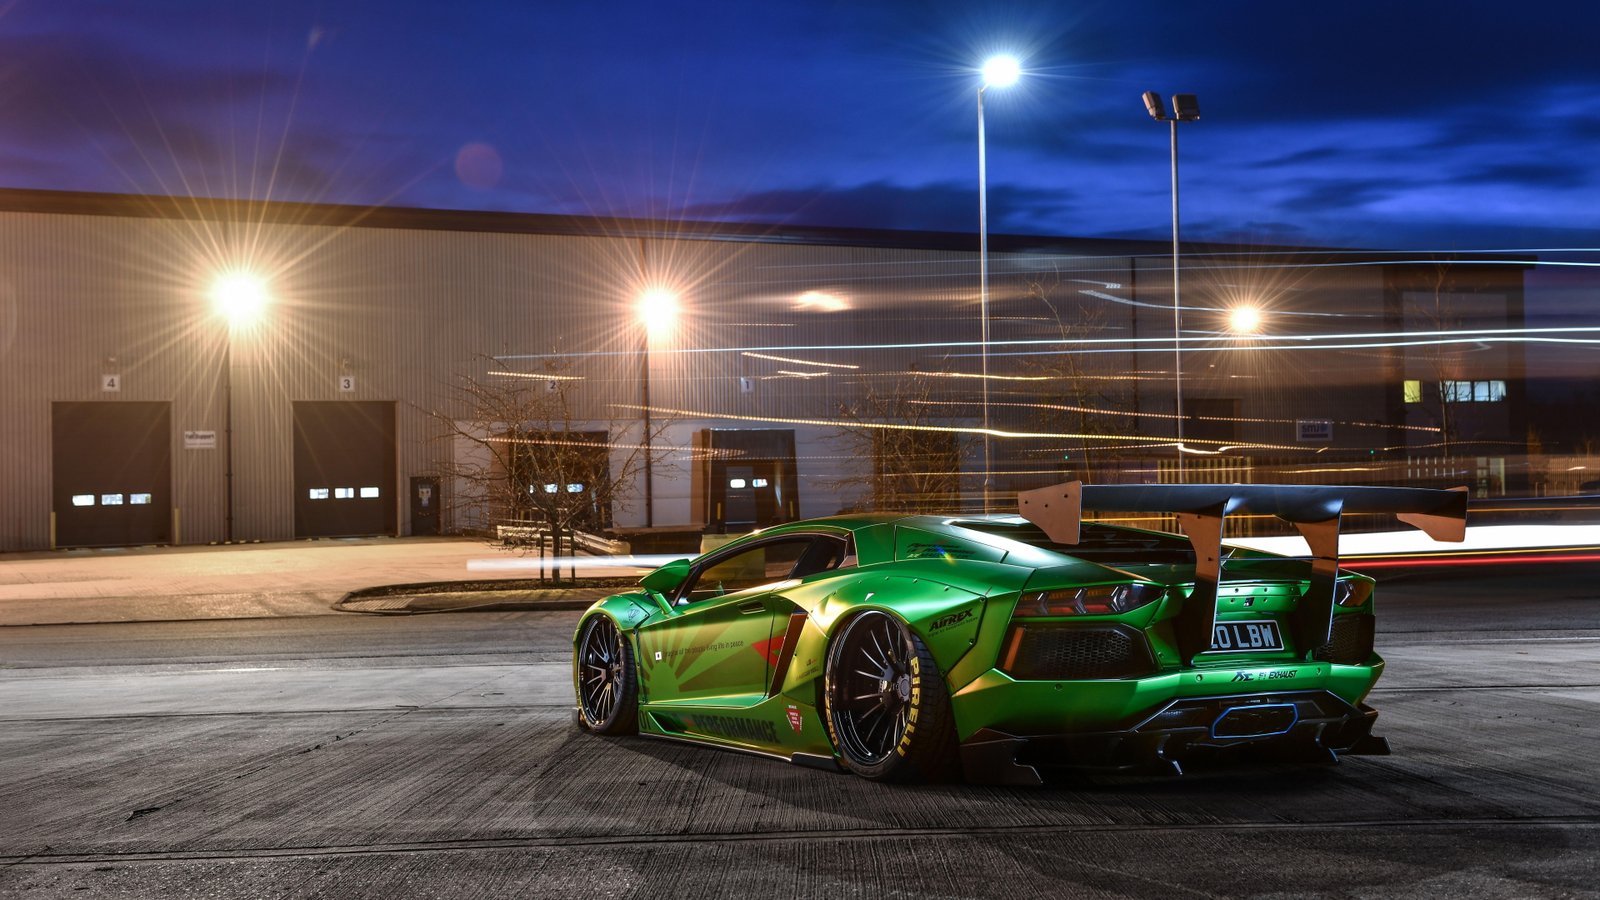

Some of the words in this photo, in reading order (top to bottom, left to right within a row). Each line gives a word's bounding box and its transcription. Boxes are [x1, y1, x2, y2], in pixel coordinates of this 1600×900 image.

[107, 378, 116, 388] 4
[343, 379, 351, 389] 3
[1233, 624, 1275, 648] LBW
[730, 640, 744, 649] peace
[1268, 669, 1298, 680] EXHAUST
[896, 656, 920, 757] PIRELLI
[692, 714, 782, 744] PERFORMANCE
